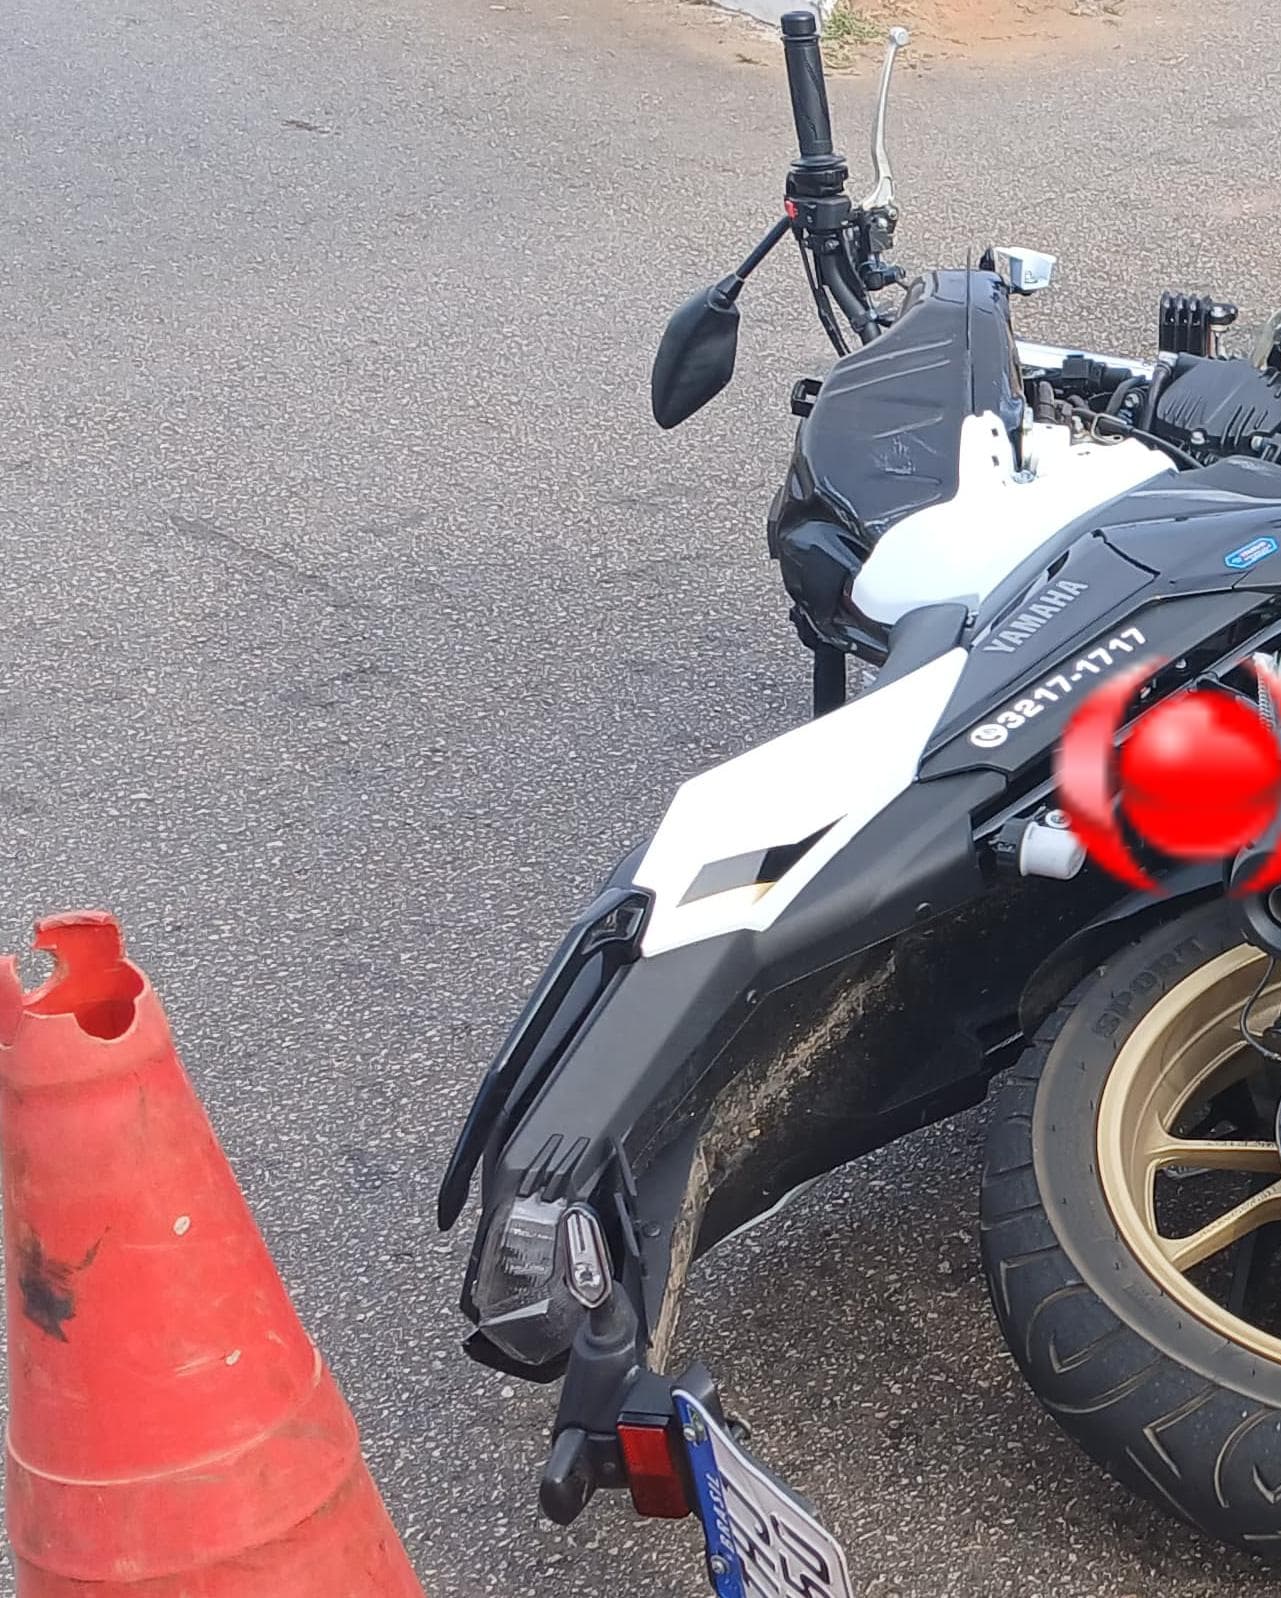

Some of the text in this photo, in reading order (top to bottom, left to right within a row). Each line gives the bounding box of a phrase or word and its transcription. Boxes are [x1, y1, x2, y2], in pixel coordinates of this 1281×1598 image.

[984, 577, 1088, 656] YAMAHA
[1000, 627, 1146, 729] 3217-1717
[706, 1474, 735, 1554] BRASIL
